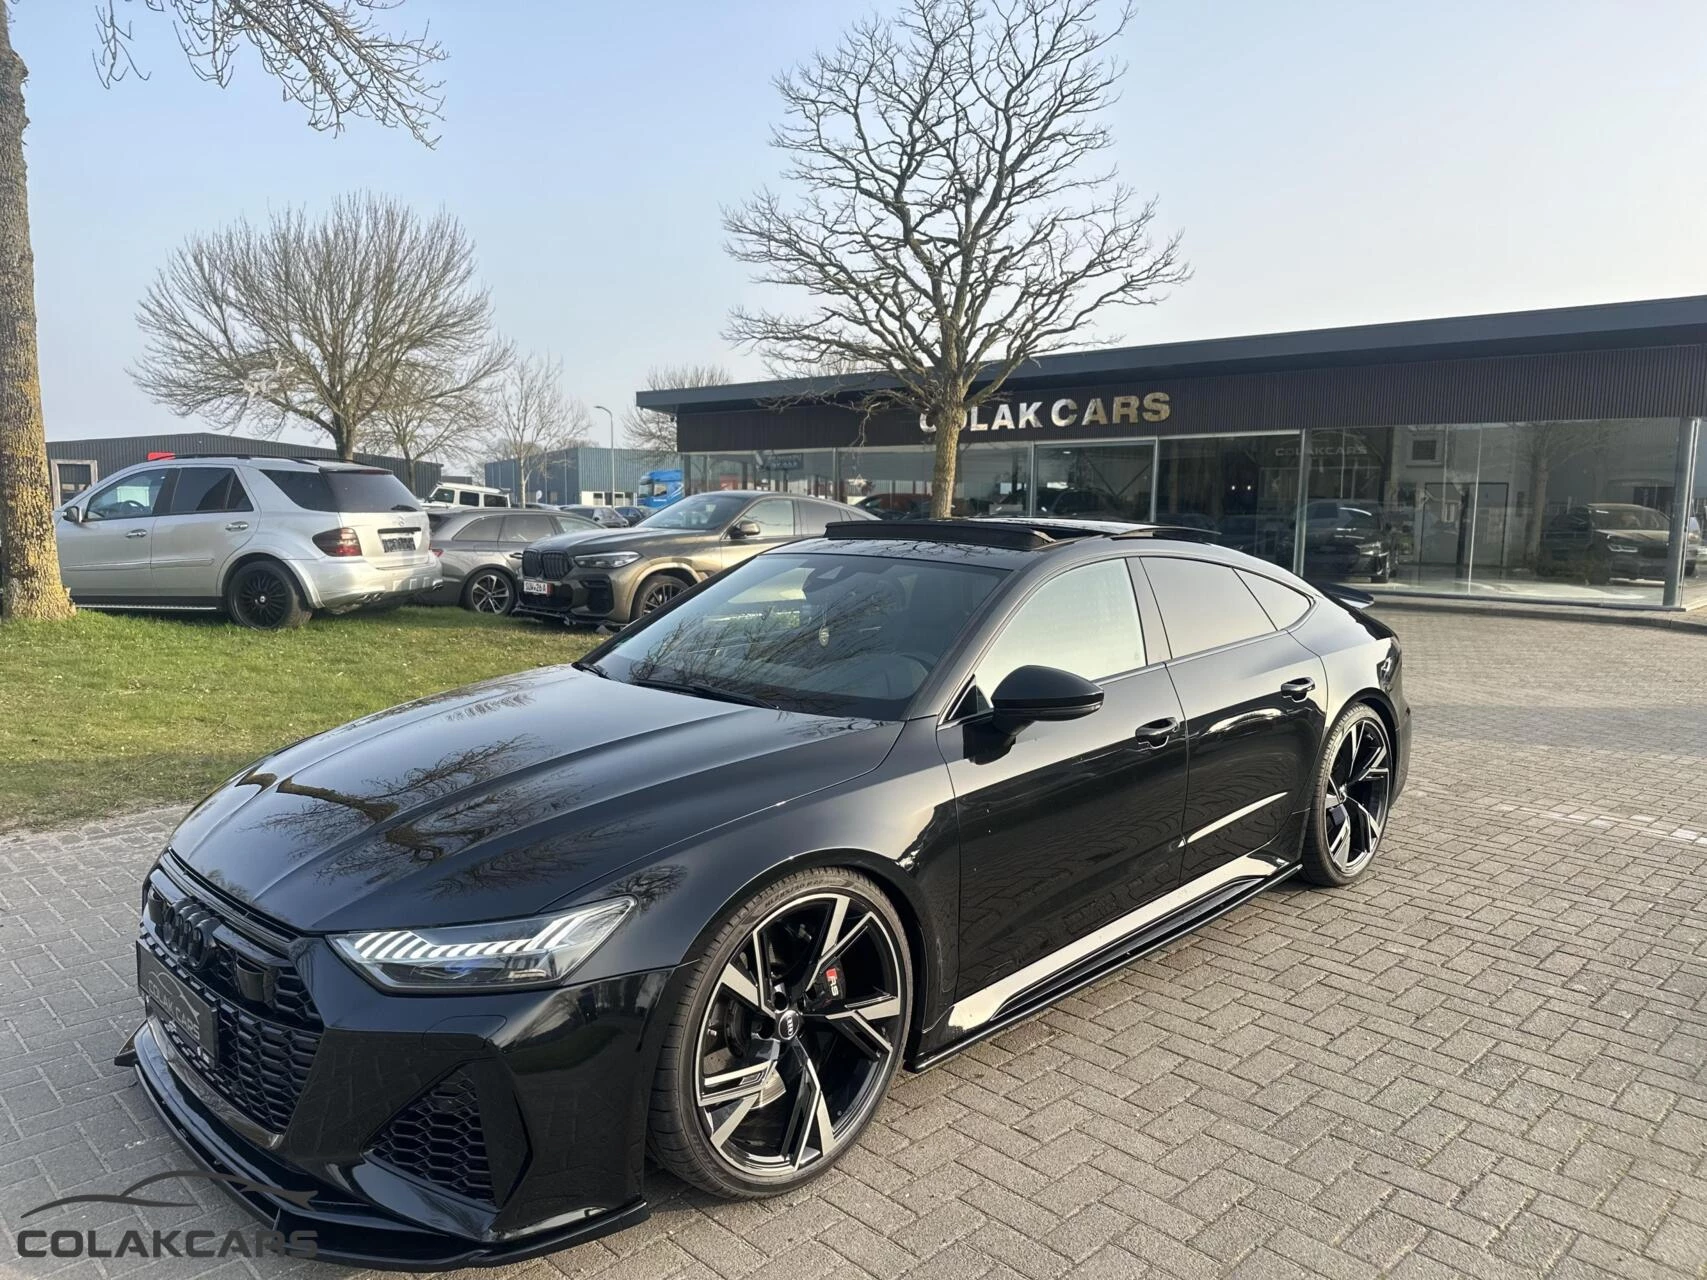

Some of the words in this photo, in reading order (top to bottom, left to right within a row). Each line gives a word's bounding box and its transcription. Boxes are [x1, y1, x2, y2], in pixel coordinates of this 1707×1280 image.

[919, 401, 1043, 433] CLAK
[1051, 392, 1171, 427] CARS
[175, 1005, 201, 1041] CARS
